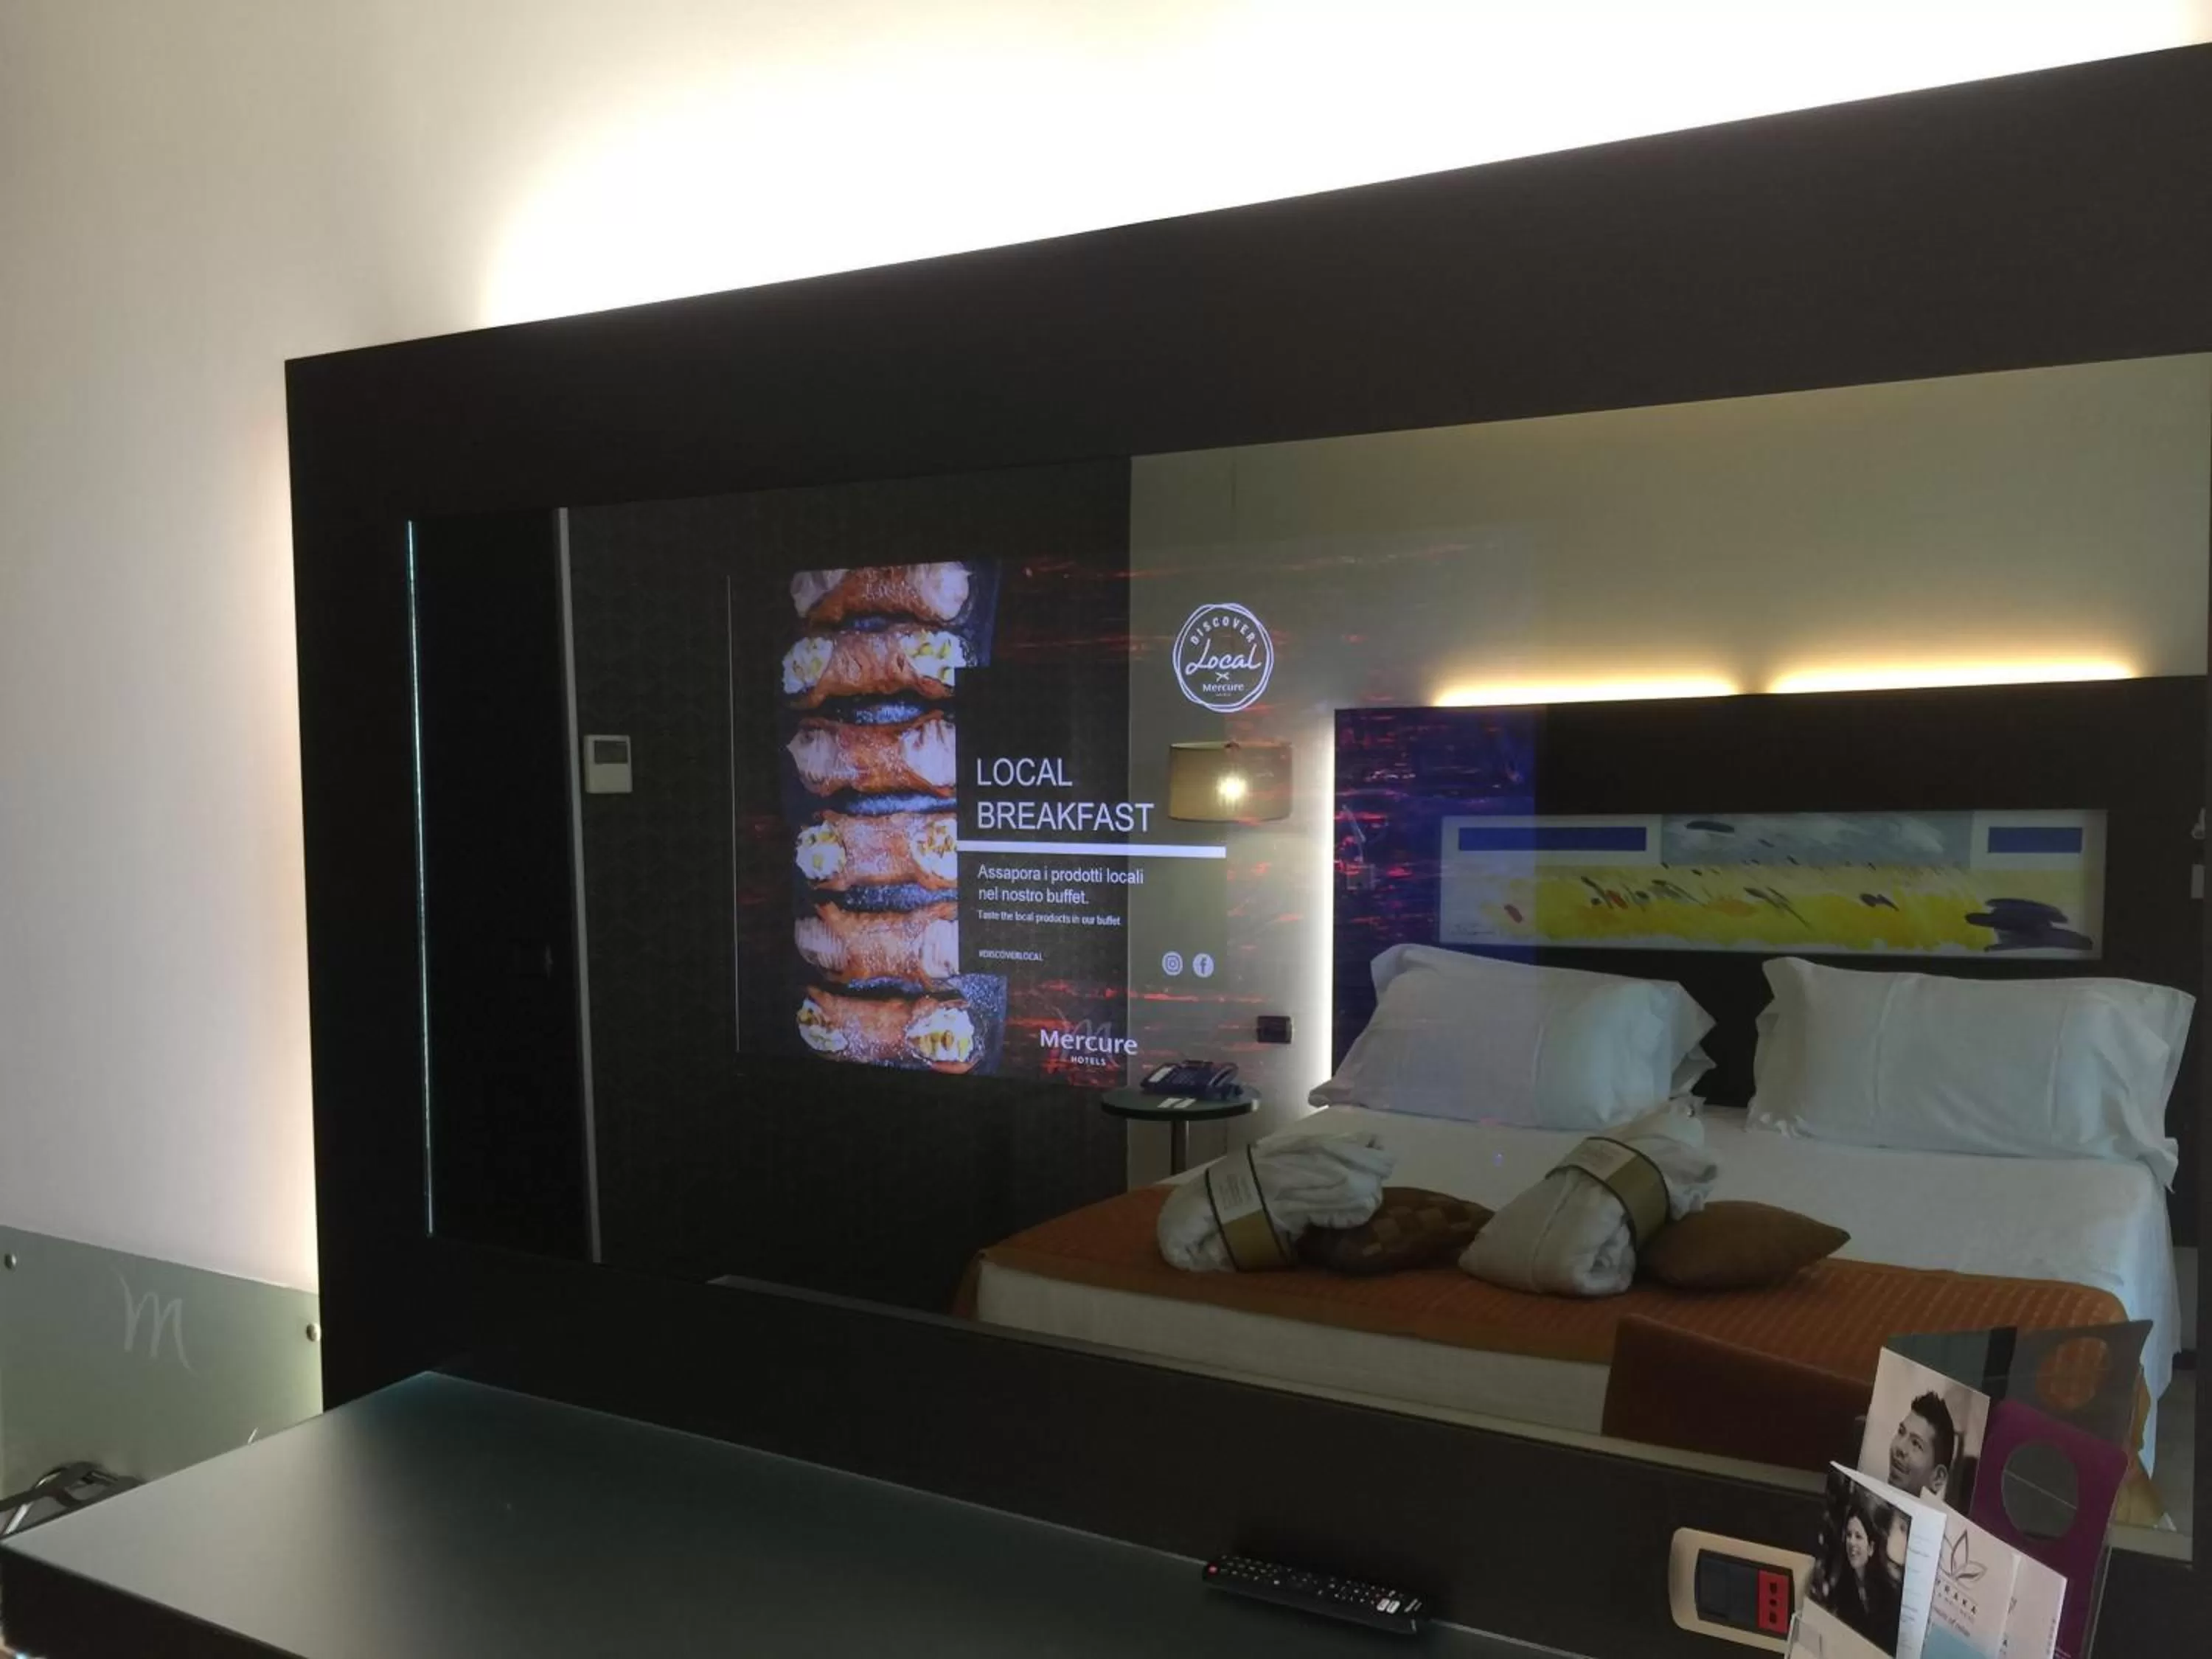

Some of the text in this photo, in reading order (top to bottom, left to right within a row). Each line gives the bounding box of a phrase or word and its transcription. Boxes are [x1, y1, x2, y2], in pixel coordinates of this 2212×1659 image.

[1190, 616, 1255, 645] DISCOVER
[1185, 638, 1262, 675] Local
[1203, 684, 1245, 692] Mercure
[977, 758, 1073, 787] LOCAL
[978, 801, 1154, 832] BREAKFAST
[978, 864, 1041, 883] Assapora
[1051, 866, 1103, 884] prodotti
[1107, 868, 1144, 884] locali
[978, 887, 1089, 905] nel nostro buffet.
[977, 910, 1121, 925] Taste the local products in our buffet
[1040, 1029, 1138, 1055] Mercure
[1071, 1055, 1106, 1066] HOTELS
